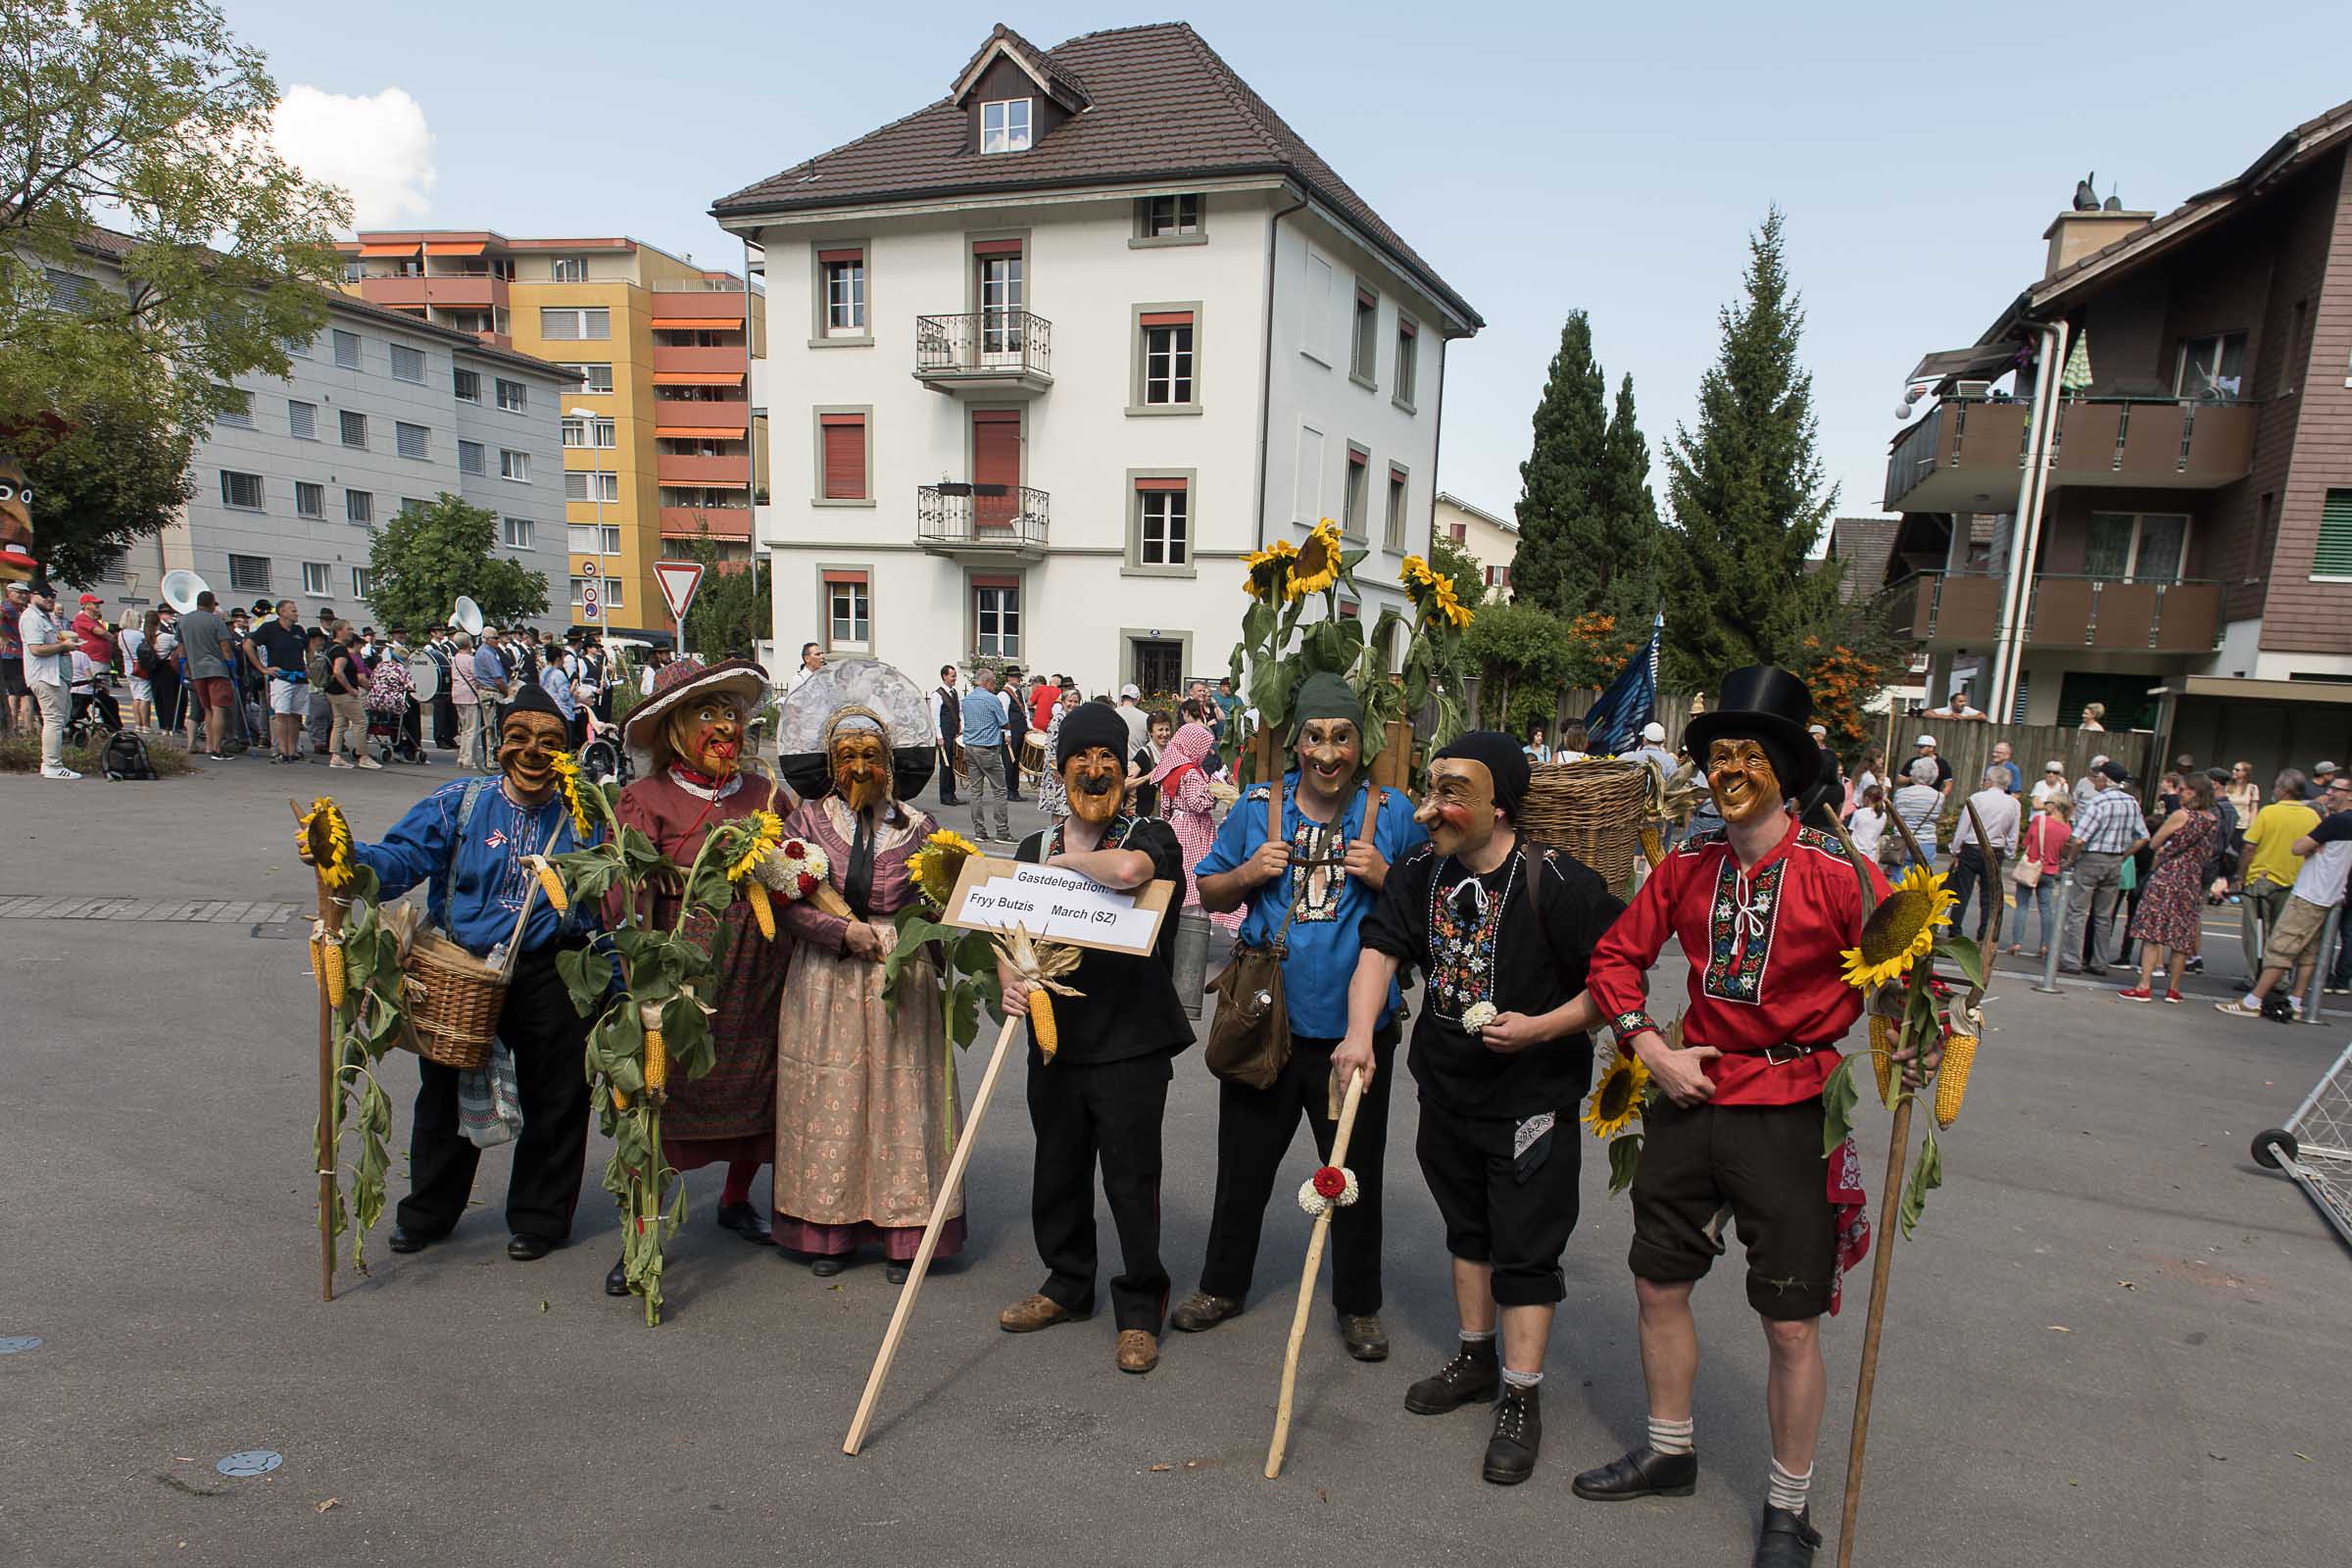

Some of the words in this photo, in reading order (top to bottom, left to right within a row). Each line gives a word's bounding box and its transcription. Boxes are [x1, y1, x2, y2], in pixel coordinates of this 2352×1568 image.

[970, 893, 995, 907] Fryy
[998, 897, 1034, 911] Butzis
[1051, 905, 1088, 919] March
[1091, 909, 1117, 926] (SZ)
